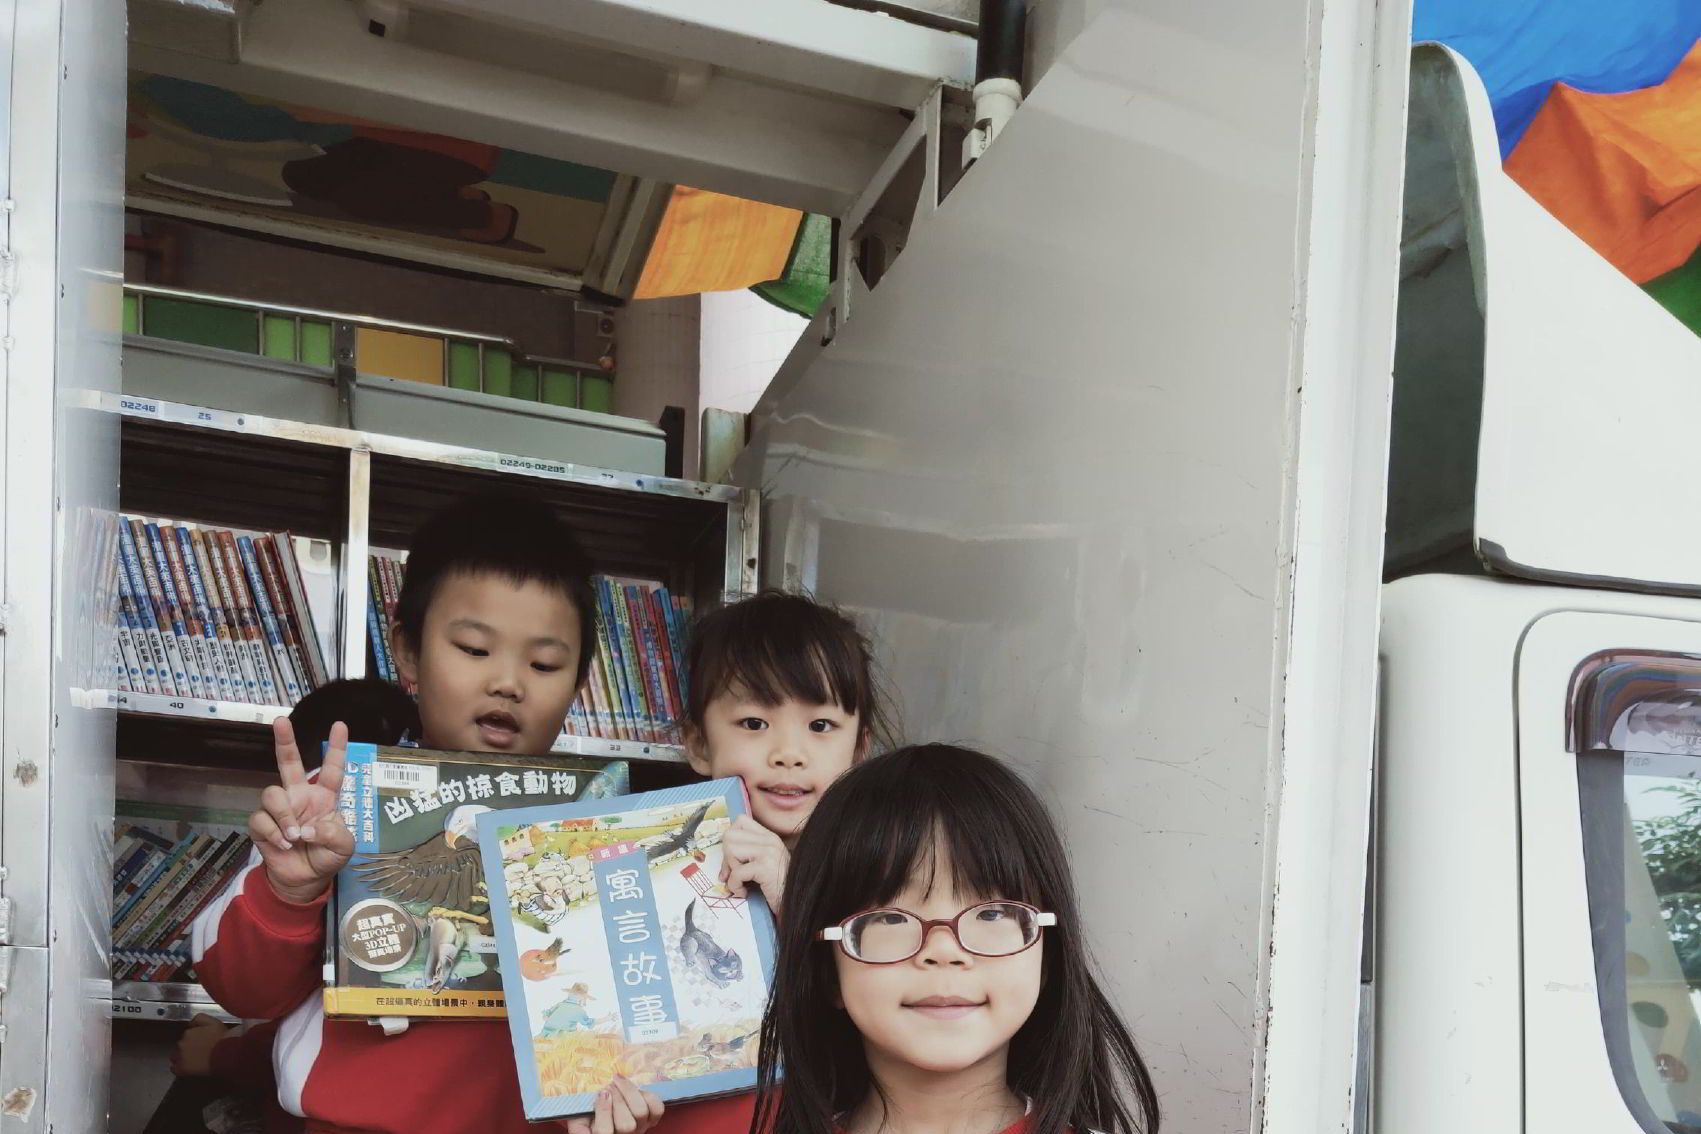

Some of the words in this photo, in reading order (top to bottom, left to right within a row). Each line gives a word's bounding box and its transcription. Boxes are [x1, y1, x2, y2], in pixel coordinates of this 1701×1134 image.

[384, 770, 577, 825] 凶猛的掠食動物
[606, 868, 667, 1025] 寓言故事
[112, 1005, 141, 1013] 2100
